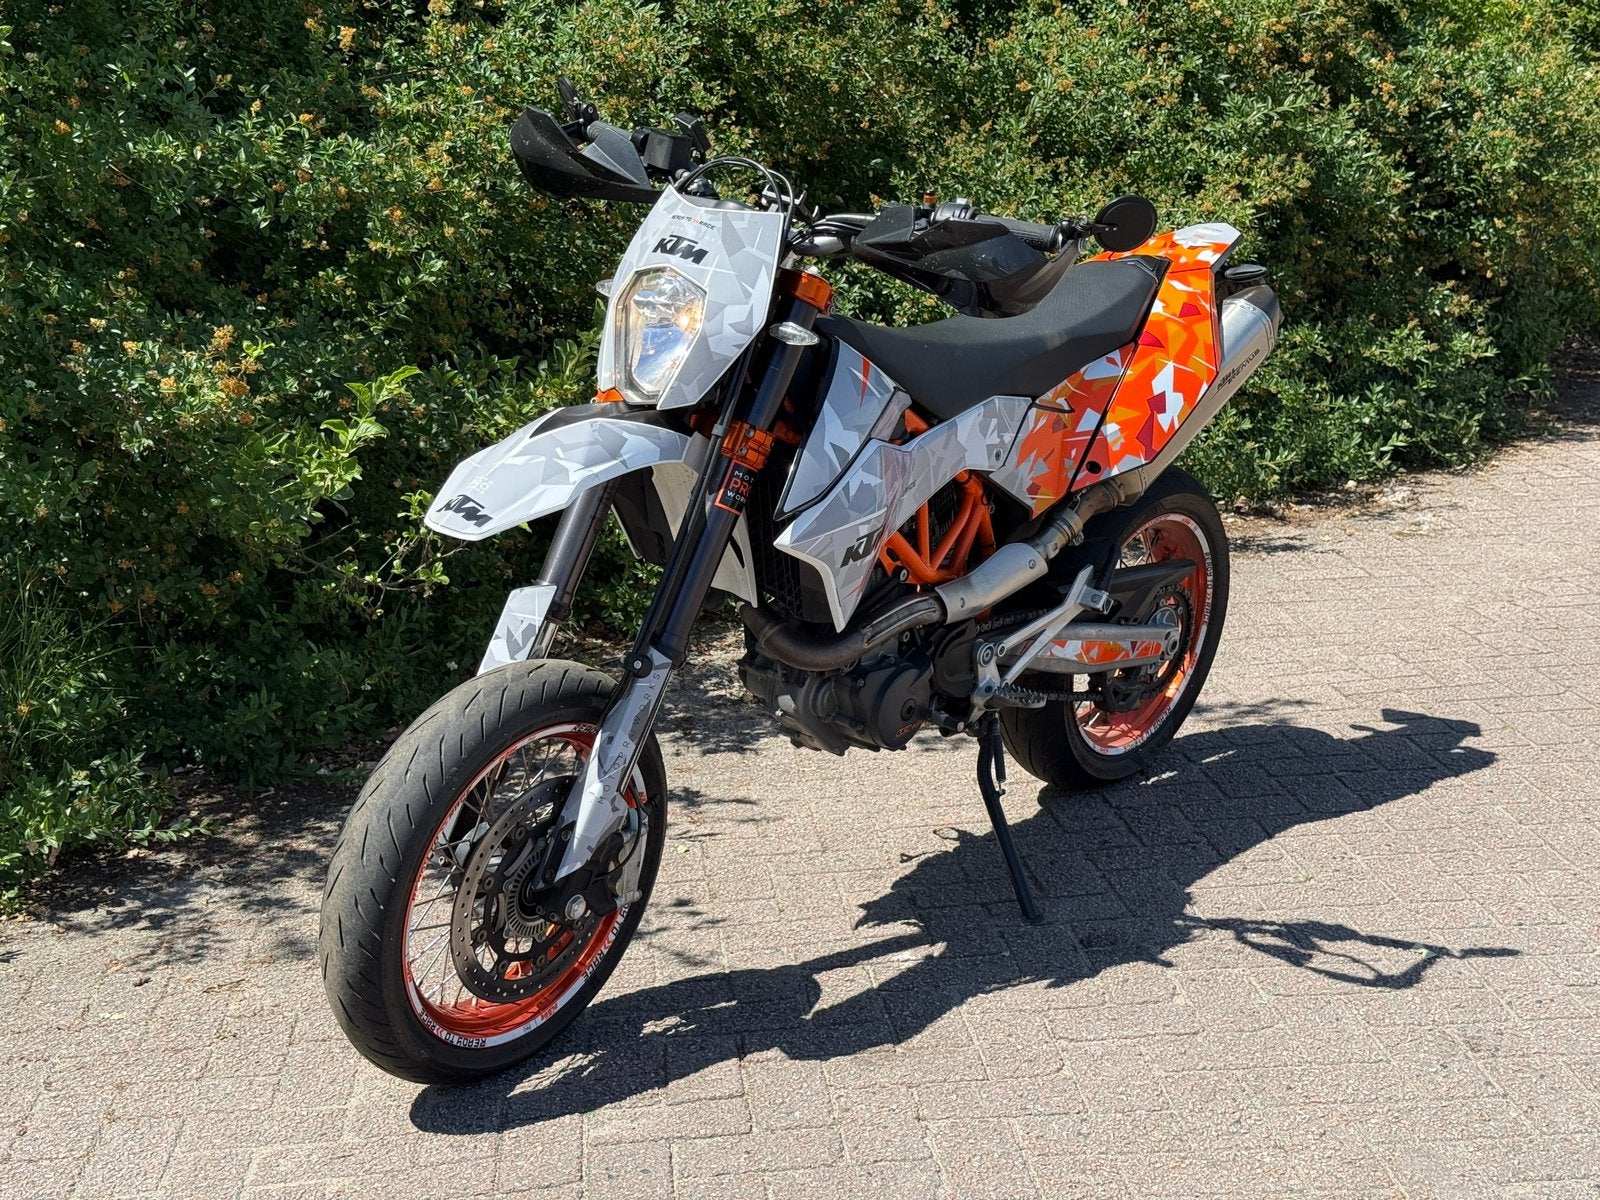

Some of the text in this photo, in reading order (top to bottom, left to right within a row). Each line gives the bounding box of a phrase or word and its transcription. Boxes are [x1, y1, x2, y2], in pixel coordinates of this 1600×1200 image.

[652, 234, 709, 265] KTM
[729, 477, 752, 498] PR
[436, 494, 494, 528] KTM
[840, 525, 884, 568] KT
[582, 921, 622, 981] TO RACE
[418, 1009, 487, 1048] READY TO RACE
